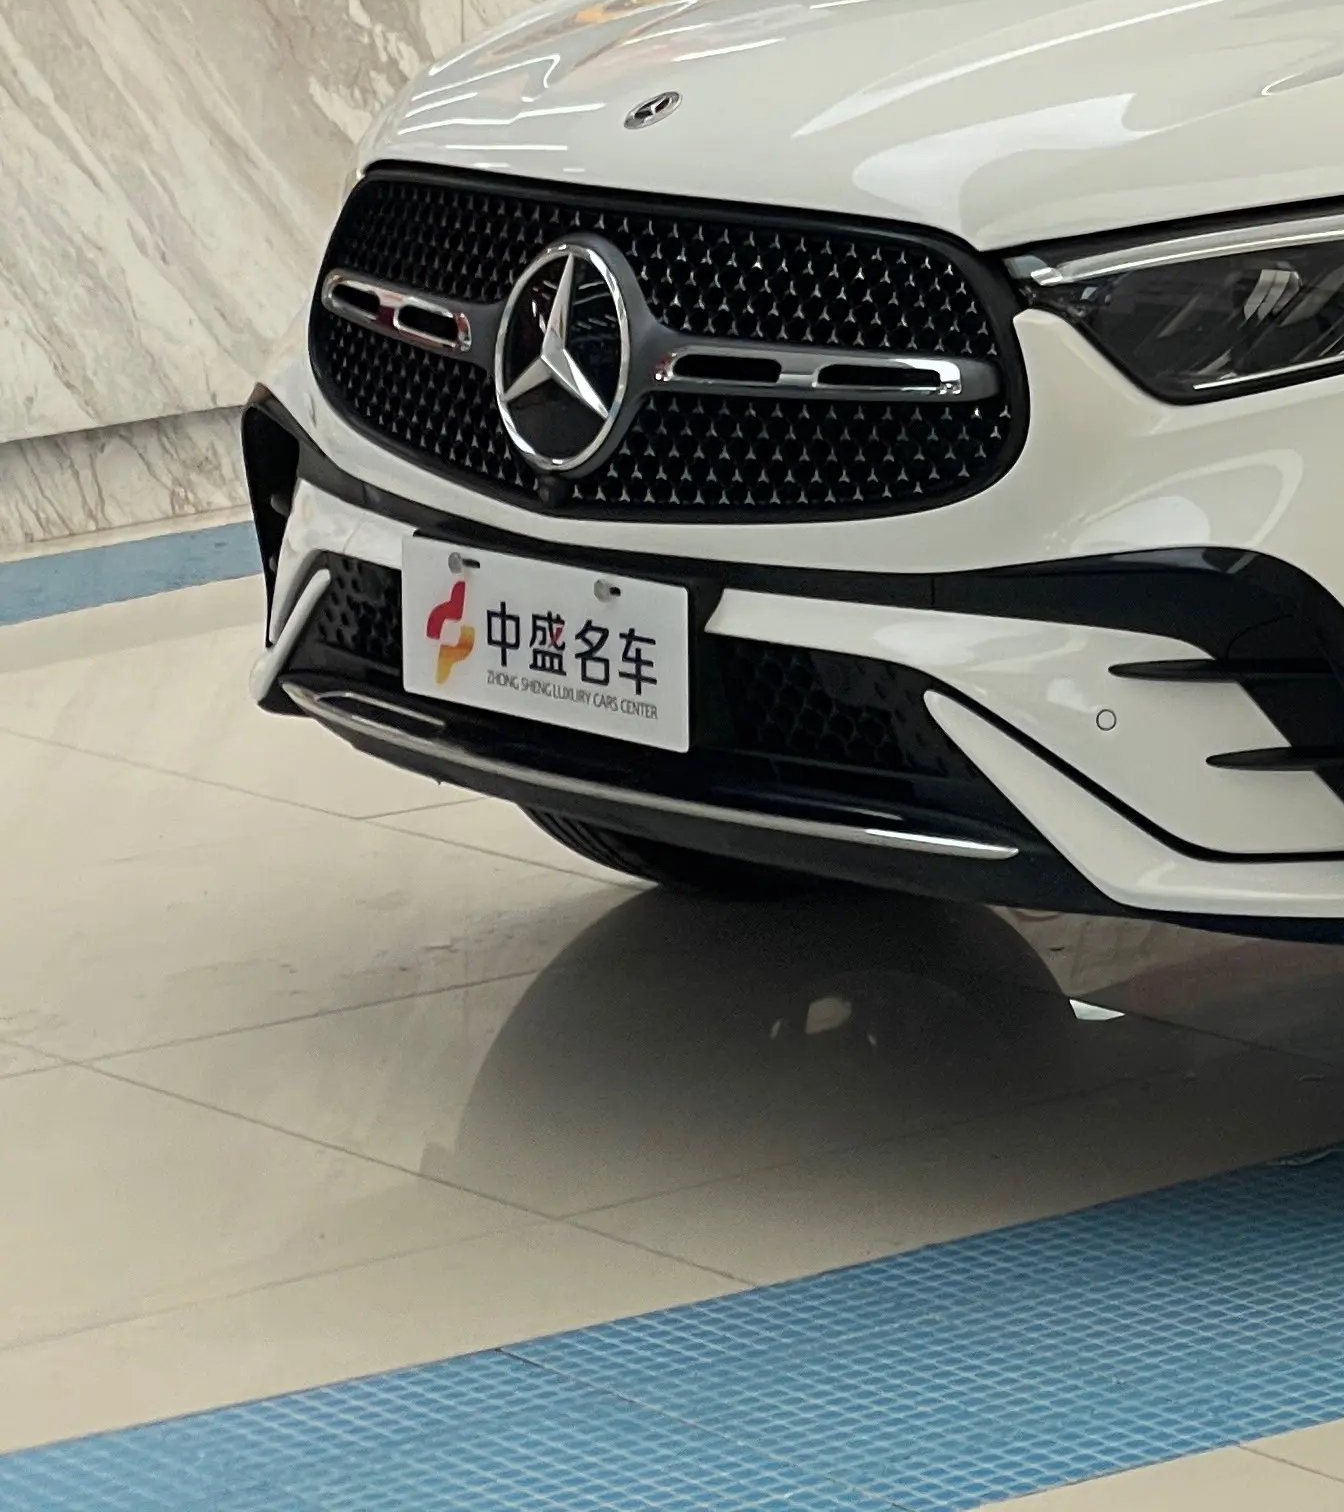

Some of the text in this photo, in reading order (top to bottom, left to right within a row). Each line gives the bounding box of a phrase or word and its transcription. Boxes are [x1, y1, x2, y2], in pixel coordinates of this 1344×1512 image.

[486, 601, 658, 696] 中盛名车
[487, 670, 658, 720] ZHONG SHENG LUXURY CARS CENTER
